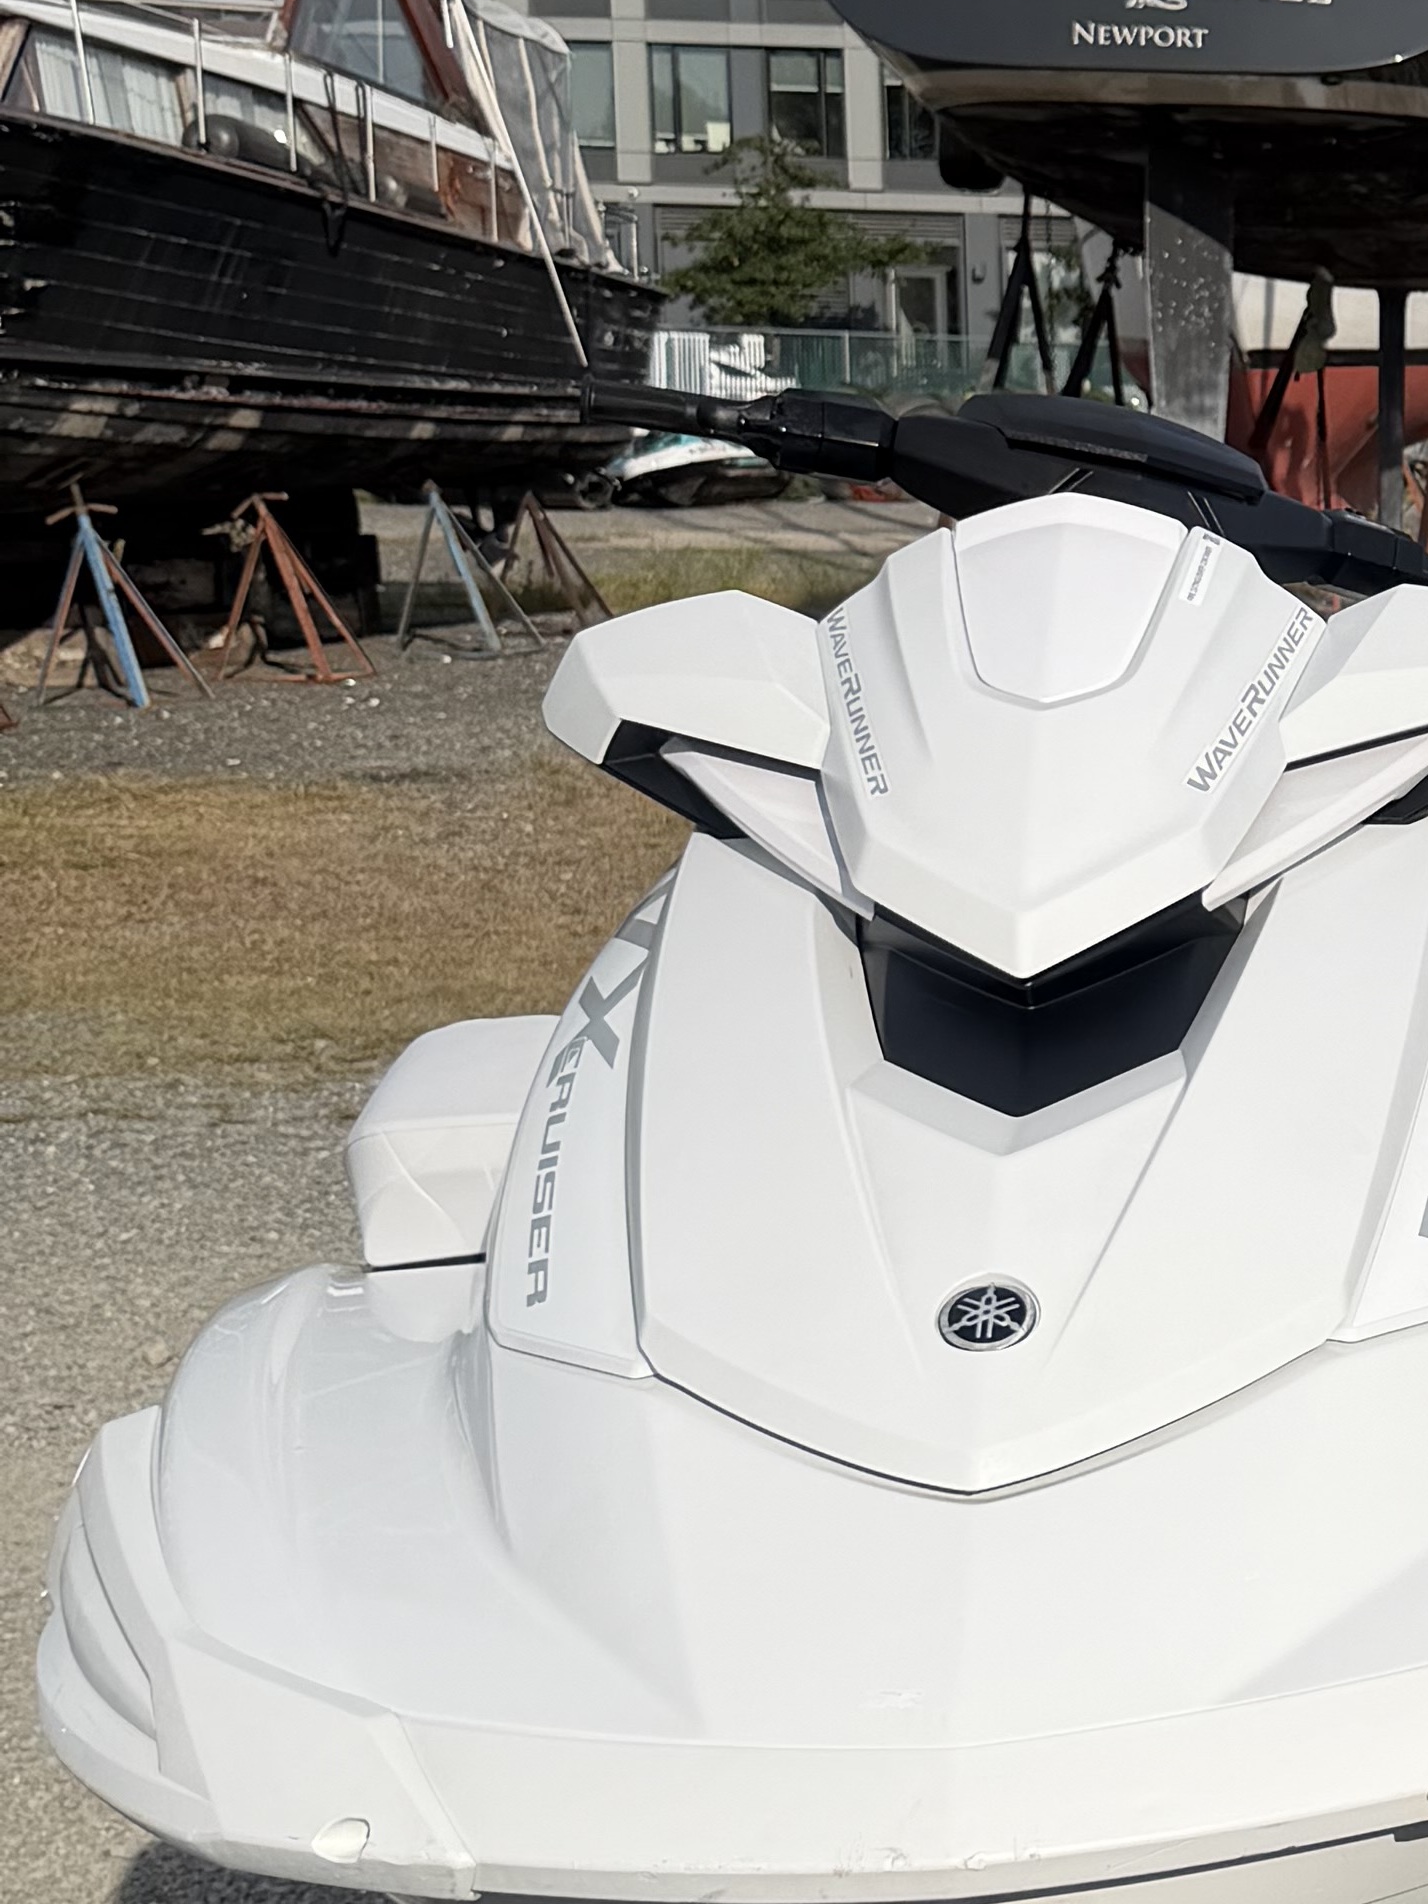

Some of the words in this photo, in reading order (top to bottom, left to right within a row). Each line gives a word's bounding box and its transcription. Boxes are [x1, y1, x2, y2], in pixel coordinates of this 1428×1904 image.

[1072, 19, 1209, 50] NEWPORT
[826, 606, 890, 797] WAVERUNNER
[1186, 607, 1315, 793] WAVERUNNER
[526, 1035, 586, 1308] CRUISER
